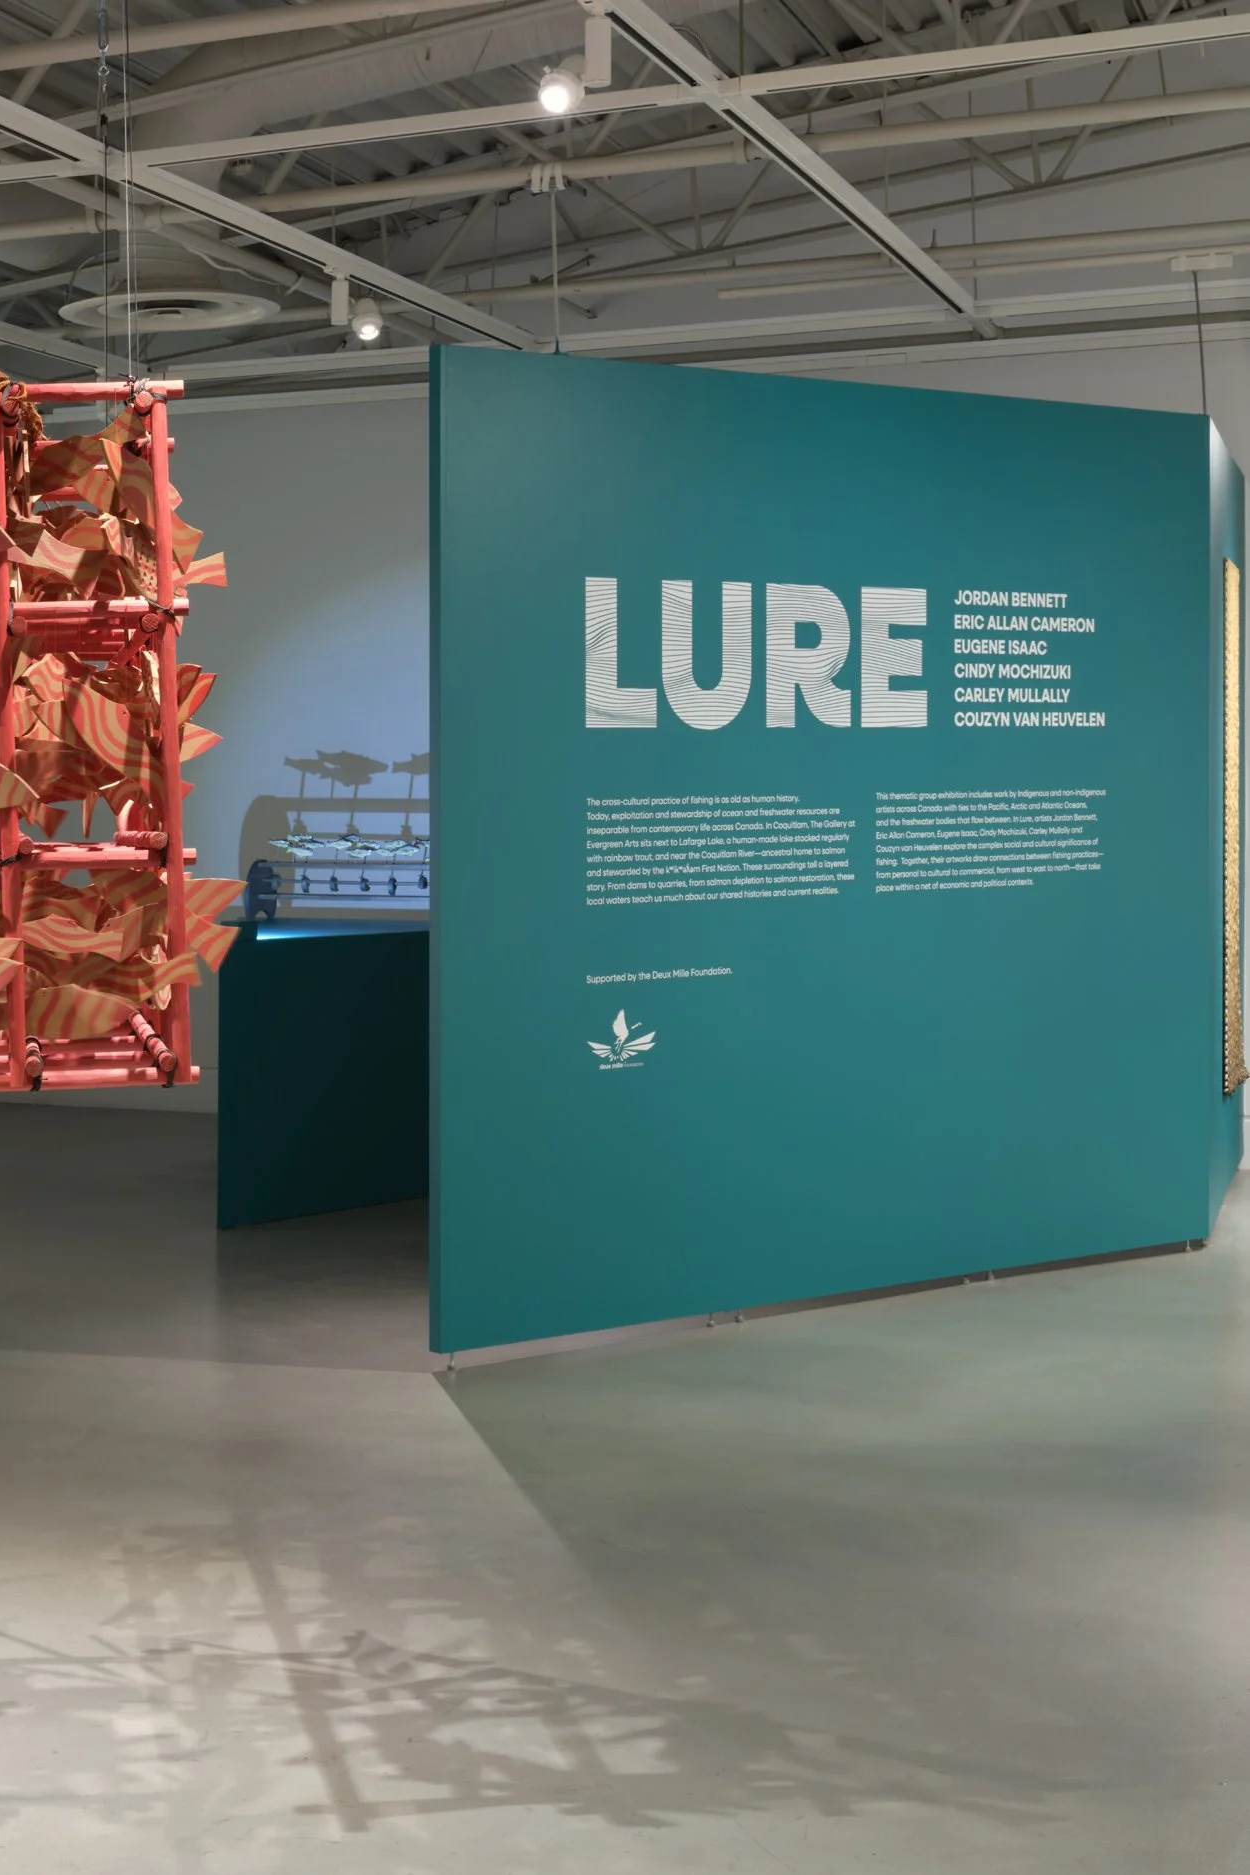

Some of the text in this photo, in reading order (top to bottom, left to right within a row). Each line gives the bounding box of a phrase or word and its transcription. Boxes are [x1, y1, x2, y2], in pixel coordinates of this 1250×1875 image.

[956, 591, 1067, 608] JORDAN BENNETT
[954, 615, 1096, 633] ERIC ALLAN CAMERON
[585, 576, 928, 730] LURE
[954, 639, 1048, 655] EUGENE ISAAC
[955, 664, 1072, 679] CINDY MOCHIZUKI
[955, 688, 1070, 703] CARLEY MULLALLY
[955, 712, 1106, 726] COUZYN VAN HEUVELEN
[588, 798, 600, 806] The
[651, 797, 681, 807] practice
[691, 796, 714, 806] fishing
[714, 796, 720, 804] is
[751, 795, 775, 803] human
[612, 811, 654, 821] exploitation
[670, 810, 713, 820] stewardship
[744, 809, 759, 817] and
[759, 808, 795, 816] freshwater
[587, 826, 629, 836] inseparable
[631, 825, 648, 833] from
[649, 824, 699, 834] contemporary
[766, 822, 772, 830] In
[823, 820, 847, 830] Gallery
[587, 840, 623, 850] Evergreen
[625, 839, 639, 847] Arts
[640, 839, 652, 847] sits
[653, 838, 669, 846] next
[671, 838, 678, 846] to
[679, 837, 706, 847] Lafarge
[794, 834, 821, 842] stocked
[821, 833, 850, 843] regularly
[587, 855, 603, 863] with
[604, 854, 633, 862] rainbow
[655, 852, 670, 860] and
[688, 851, 700, 859] the
[701, 850, 737, 861] Coquitlam
[793, 848, 813, 856] home
[814, 847, 821, 855] to
[822, 847, 846, 855] salmon
[587, 869, 602, 877] and
[603, 867, 641, 876] stewarded
[642, 867, 651, 877] by
[743, 863, 763, 871] These
[764, 861, 807, 872] surroundings
[807, 861, 818, 869] tell
[824, 860, 850, 870] layered
[608, 882, 626, 890] From
[627, 881, 647, 889] dams
[689, 879, 706, 887] from
[706, 878, 732, 886] salmon
[732, 876, 765, 887] depletion
[765, 876, 773, 884] to
[773, 875, 798, 883] salmon
[837, 873, 856, 881] these
[587, 897, 605, 905] local
[606, 896, 631, 904] waters
[632, 895, 653, 903] teach
[663, 893, 684, 901] much
[685, 892, 706, 901] about
[720, 891, 743, 899] shared
[744, 889, 772, 898] histories
[773, 889, 787, 897] and
[787, 888, 812, 896] current
[587, 965, 733, 986] Supported by the Deux Mille Foundation.
